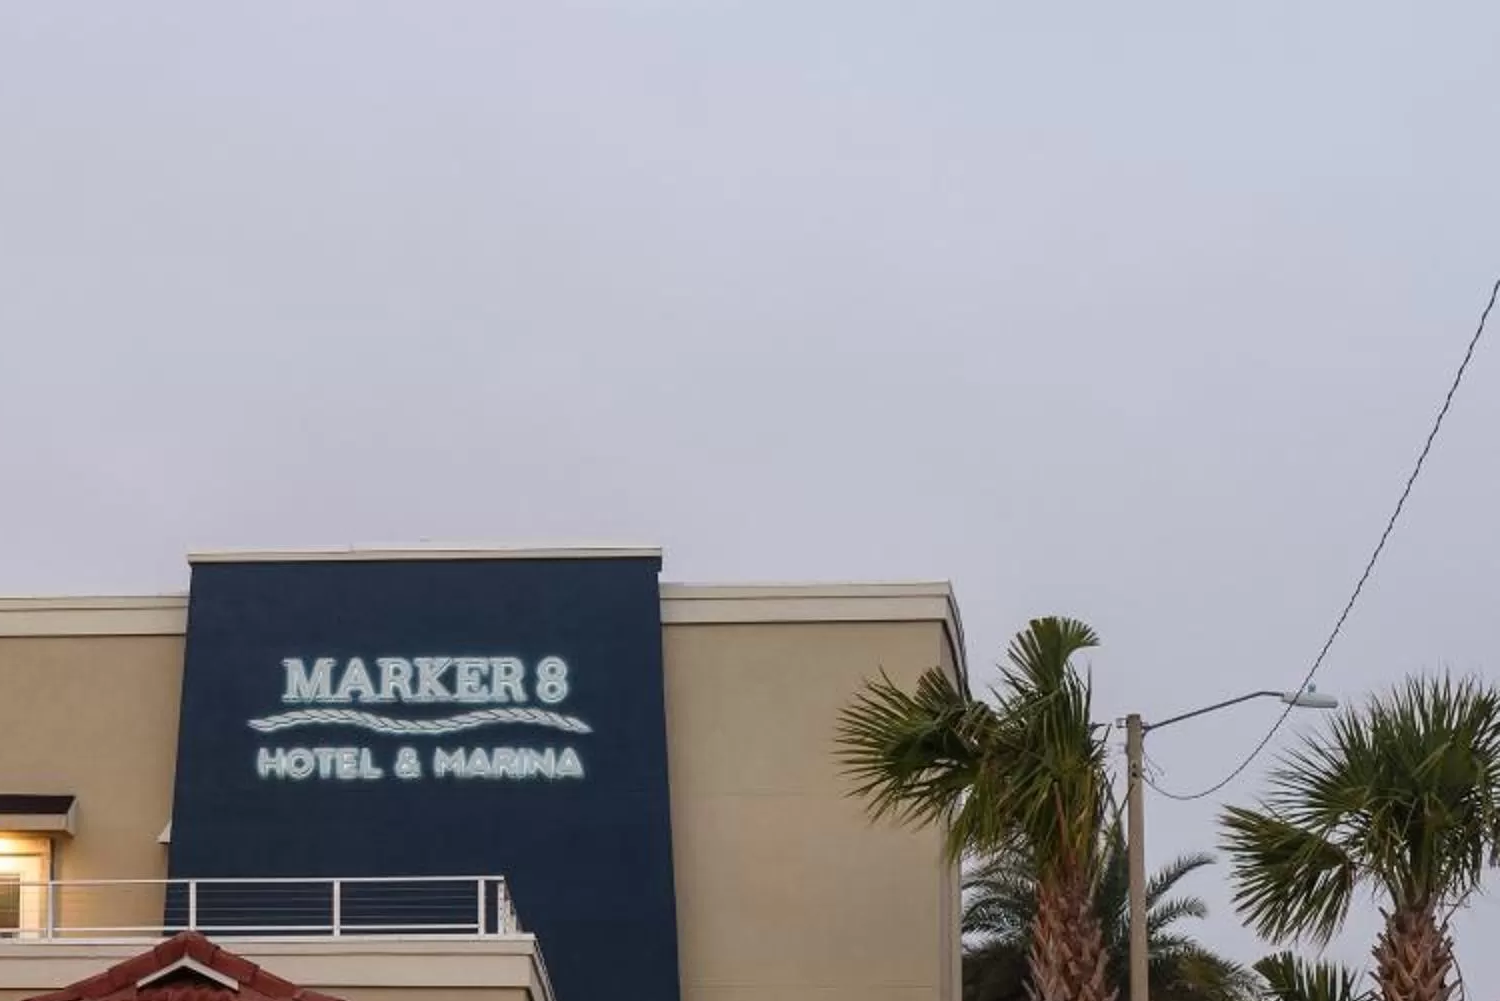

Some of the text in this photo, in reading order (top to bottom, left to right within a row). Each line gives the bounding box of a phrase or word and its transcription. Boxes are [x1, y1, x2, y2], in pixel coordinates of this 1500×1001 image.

[281, 656, 569, 703] MARKER 8
[257, 746, 583, 779] HOTEL & MARINA
